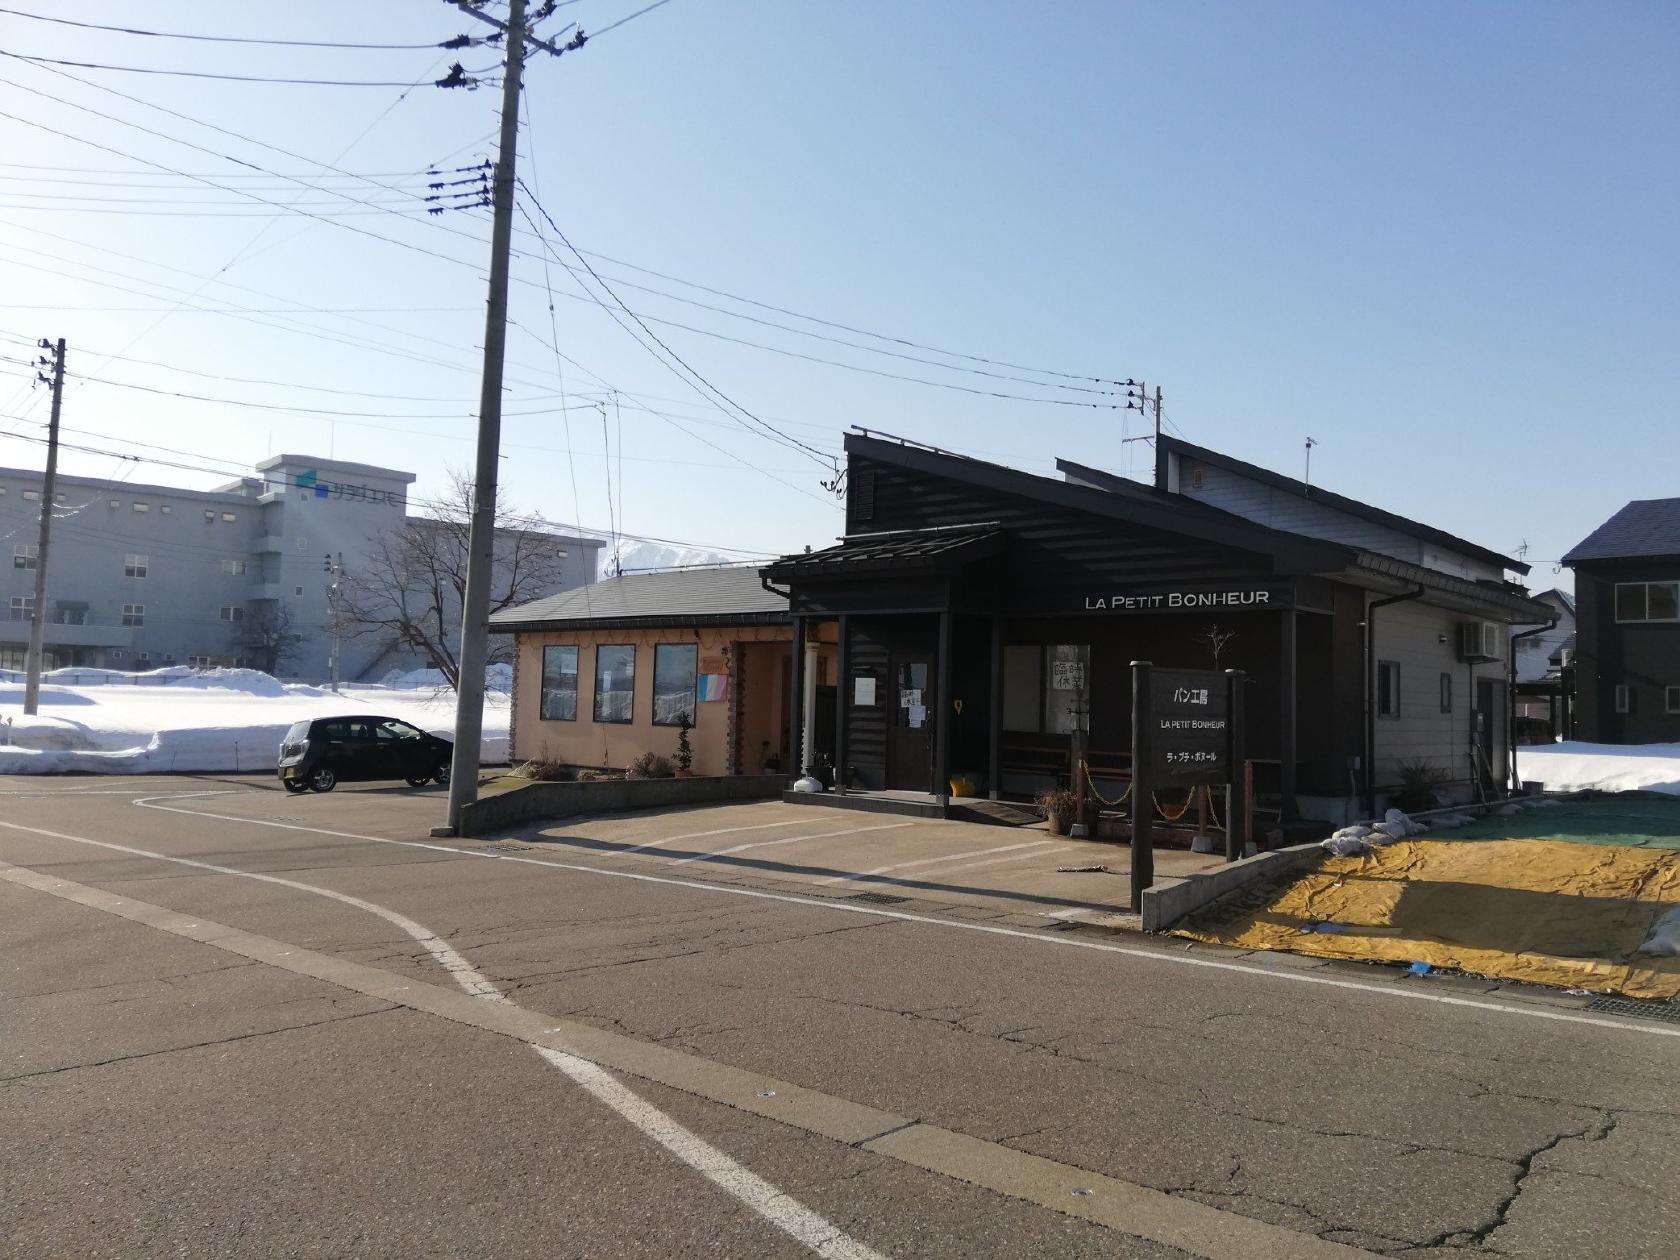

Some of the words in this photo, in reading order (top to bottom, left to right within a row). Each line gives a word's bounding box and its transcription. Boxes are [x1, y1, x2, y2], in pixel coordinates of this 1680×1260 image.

[1086, 597, 1106, 609] LA
[1112, 596, 1163, 608] PETIT
[1168, 591, 1269, 607] BONHEUR
[1174, 687, 1208, 705] パン工房
[1160, 720, 1171, 729] LA
[1171, 720, 1191, 729] PETIT
[1191, 720, 1225, 729] BONHEUR
